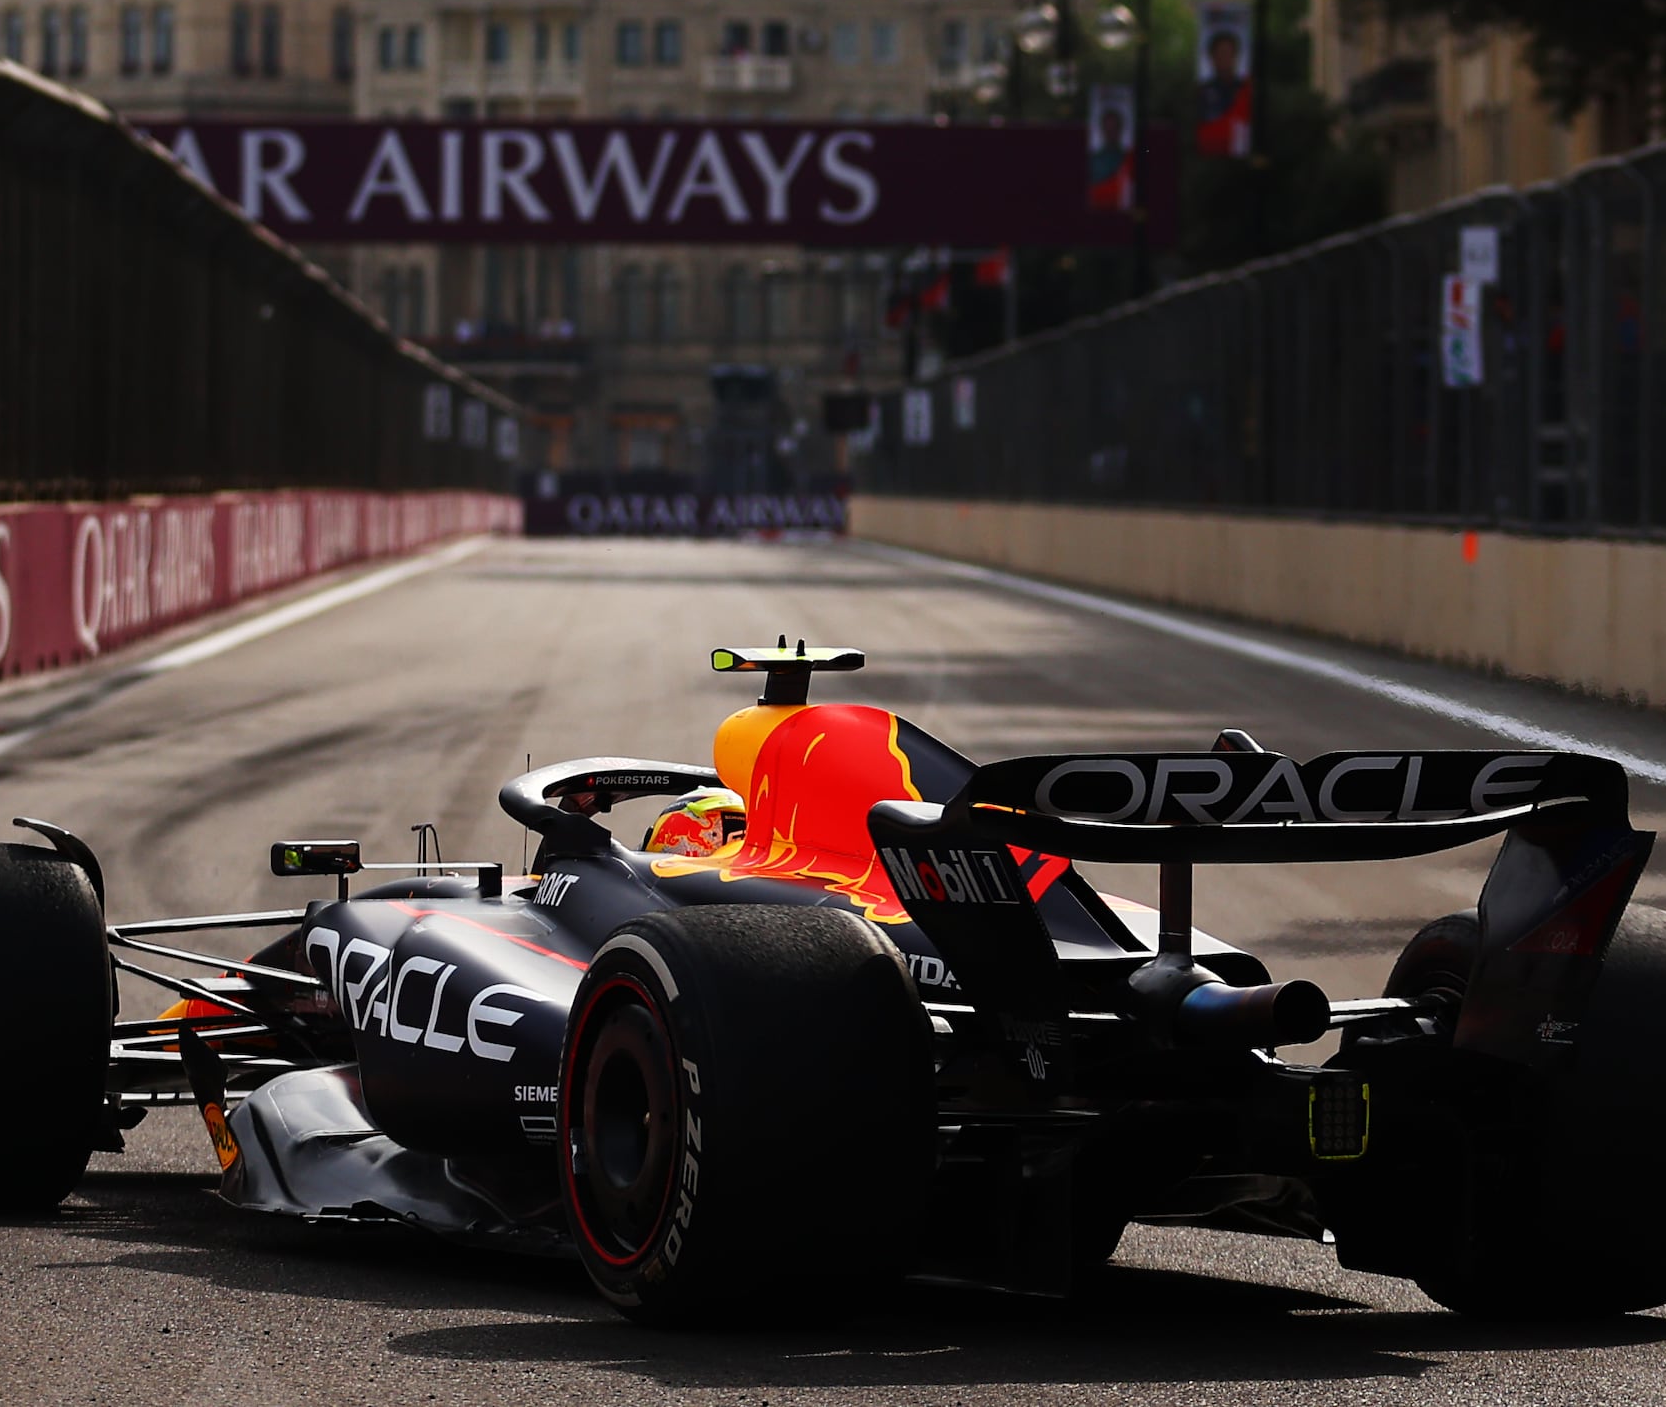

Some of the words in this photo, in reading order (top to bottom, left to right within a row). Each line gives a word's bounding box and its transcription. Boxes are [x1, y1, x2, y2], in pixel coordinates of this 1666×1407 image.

[346, 128, 880, 226] AIRWAYS
[565, 492, 700, 534] QATAR
[72, 511, 152, 656] QATAR
[595, 775, 670, 786] POKERSTARS
[1033, 755, 1555, 824] ORACLE
[533, 872, 580, 907] ROKT
[880, 846, 987, 903] Mobil
[306, 926, 552, 1063] ORACLE
[681, 1057, 702, 1097] P
[663, 1107, 703, 1268] ZERO
